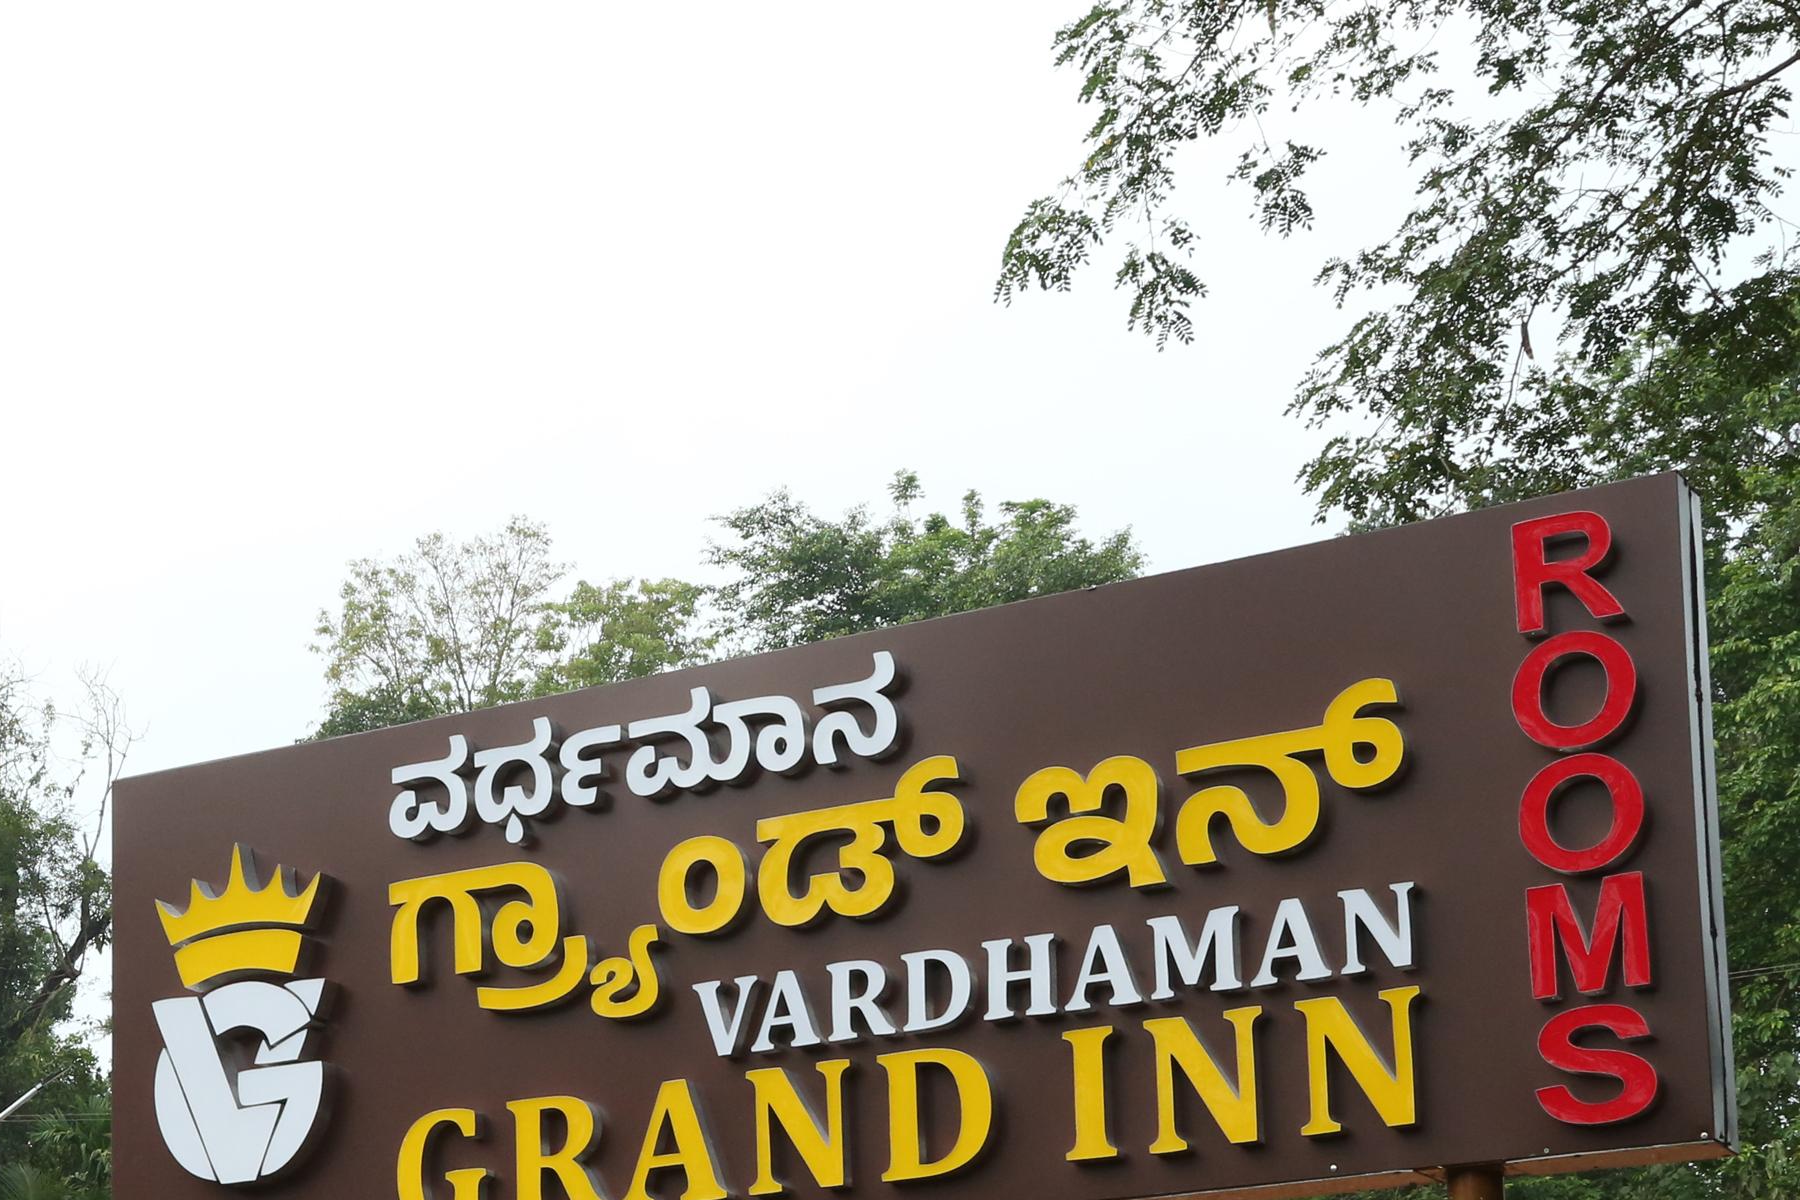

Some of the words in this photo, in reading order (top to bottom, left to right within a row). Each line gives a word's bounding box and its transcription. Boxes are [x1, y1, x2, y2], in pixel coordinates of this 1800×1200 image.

[388, 650, 898, 844] ವರ್ಧಮಾನ
[1014, 677, 1404, 888] ಇನ್
[1511, 510, 1658, 1126] ROOMS
[692, 881, 1415, 1056] VARDHAMAN
[1062, 984, 1421, 1163] INN
